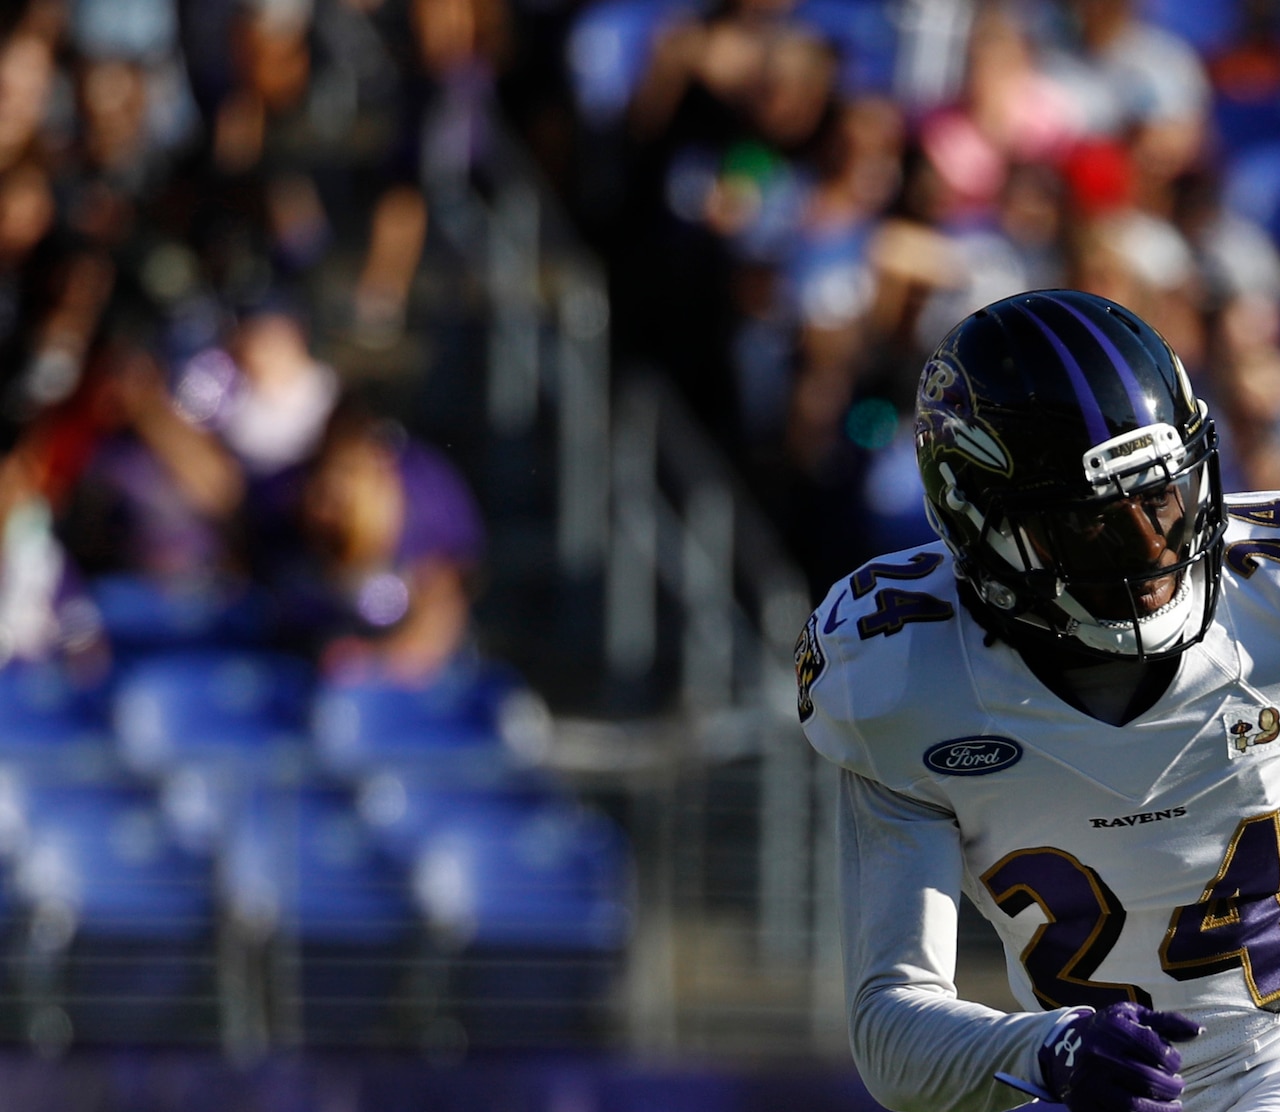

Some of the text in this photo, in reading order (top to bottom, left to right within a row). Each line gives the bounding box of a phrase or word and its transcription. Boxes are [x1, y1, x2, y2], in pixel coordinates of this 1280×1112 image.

[1107, 433, 1156, 459] RAVENS
[849, 551, 955, 640] 24
[945, 744, 1000, 768] Ford
[1089, 806, 1187, 829] RAVENS
